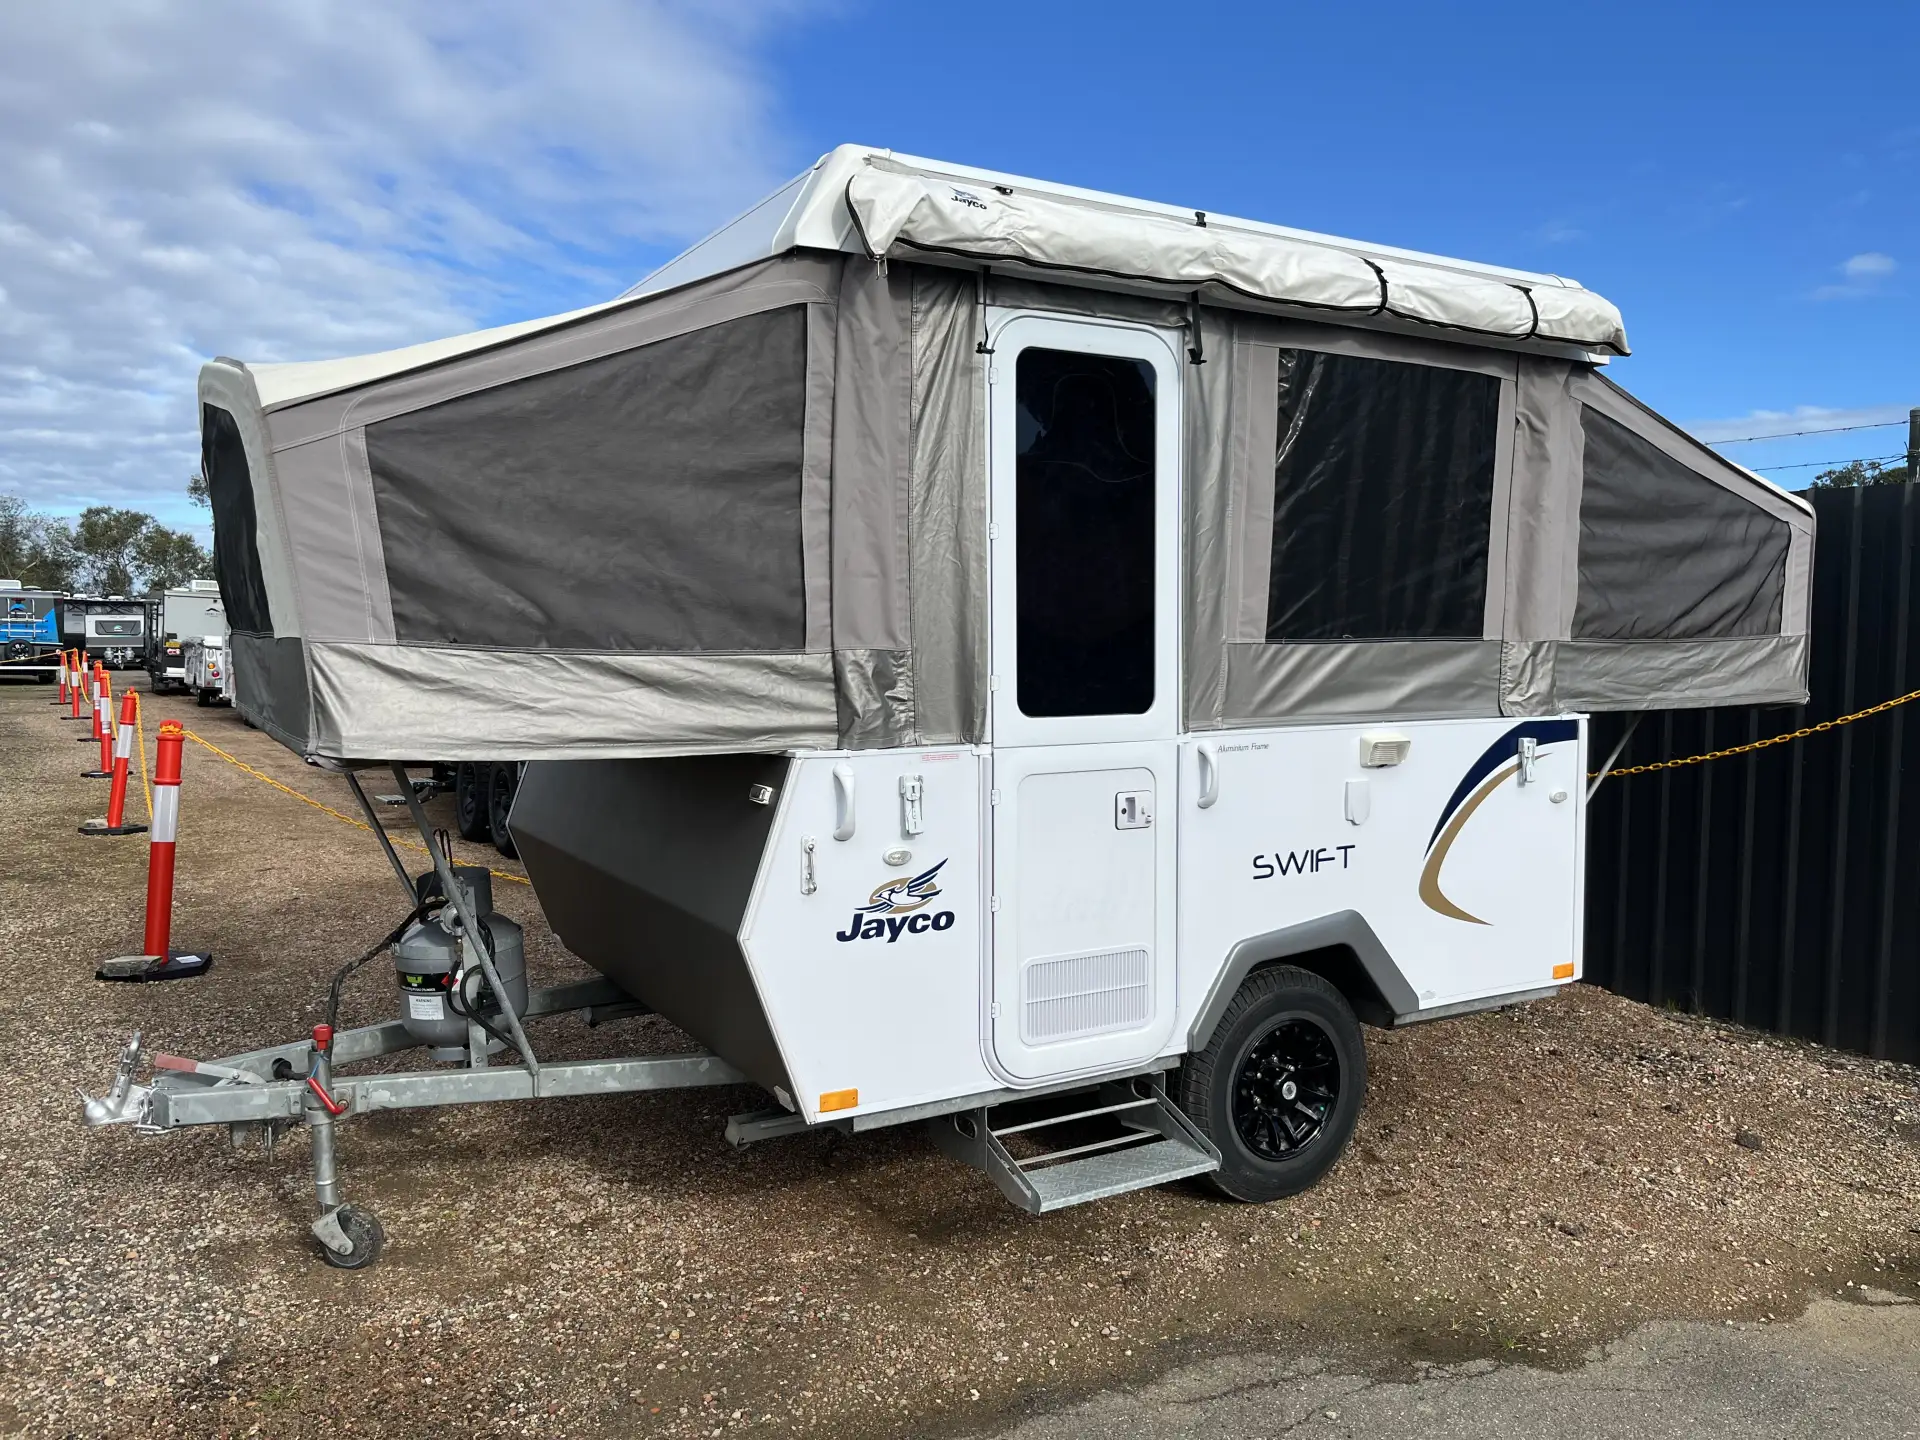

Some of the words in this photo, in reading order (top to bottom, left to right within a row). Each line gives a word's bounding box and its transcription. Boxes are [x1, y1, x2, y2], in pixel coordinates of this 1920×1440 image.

[951, 195, 987, 210] Jayco
[1250, 742, 1269, 751] Frame
[1253, 844, 1356, 880] SWIFT
[836, 911, 955, 943] Jayco
